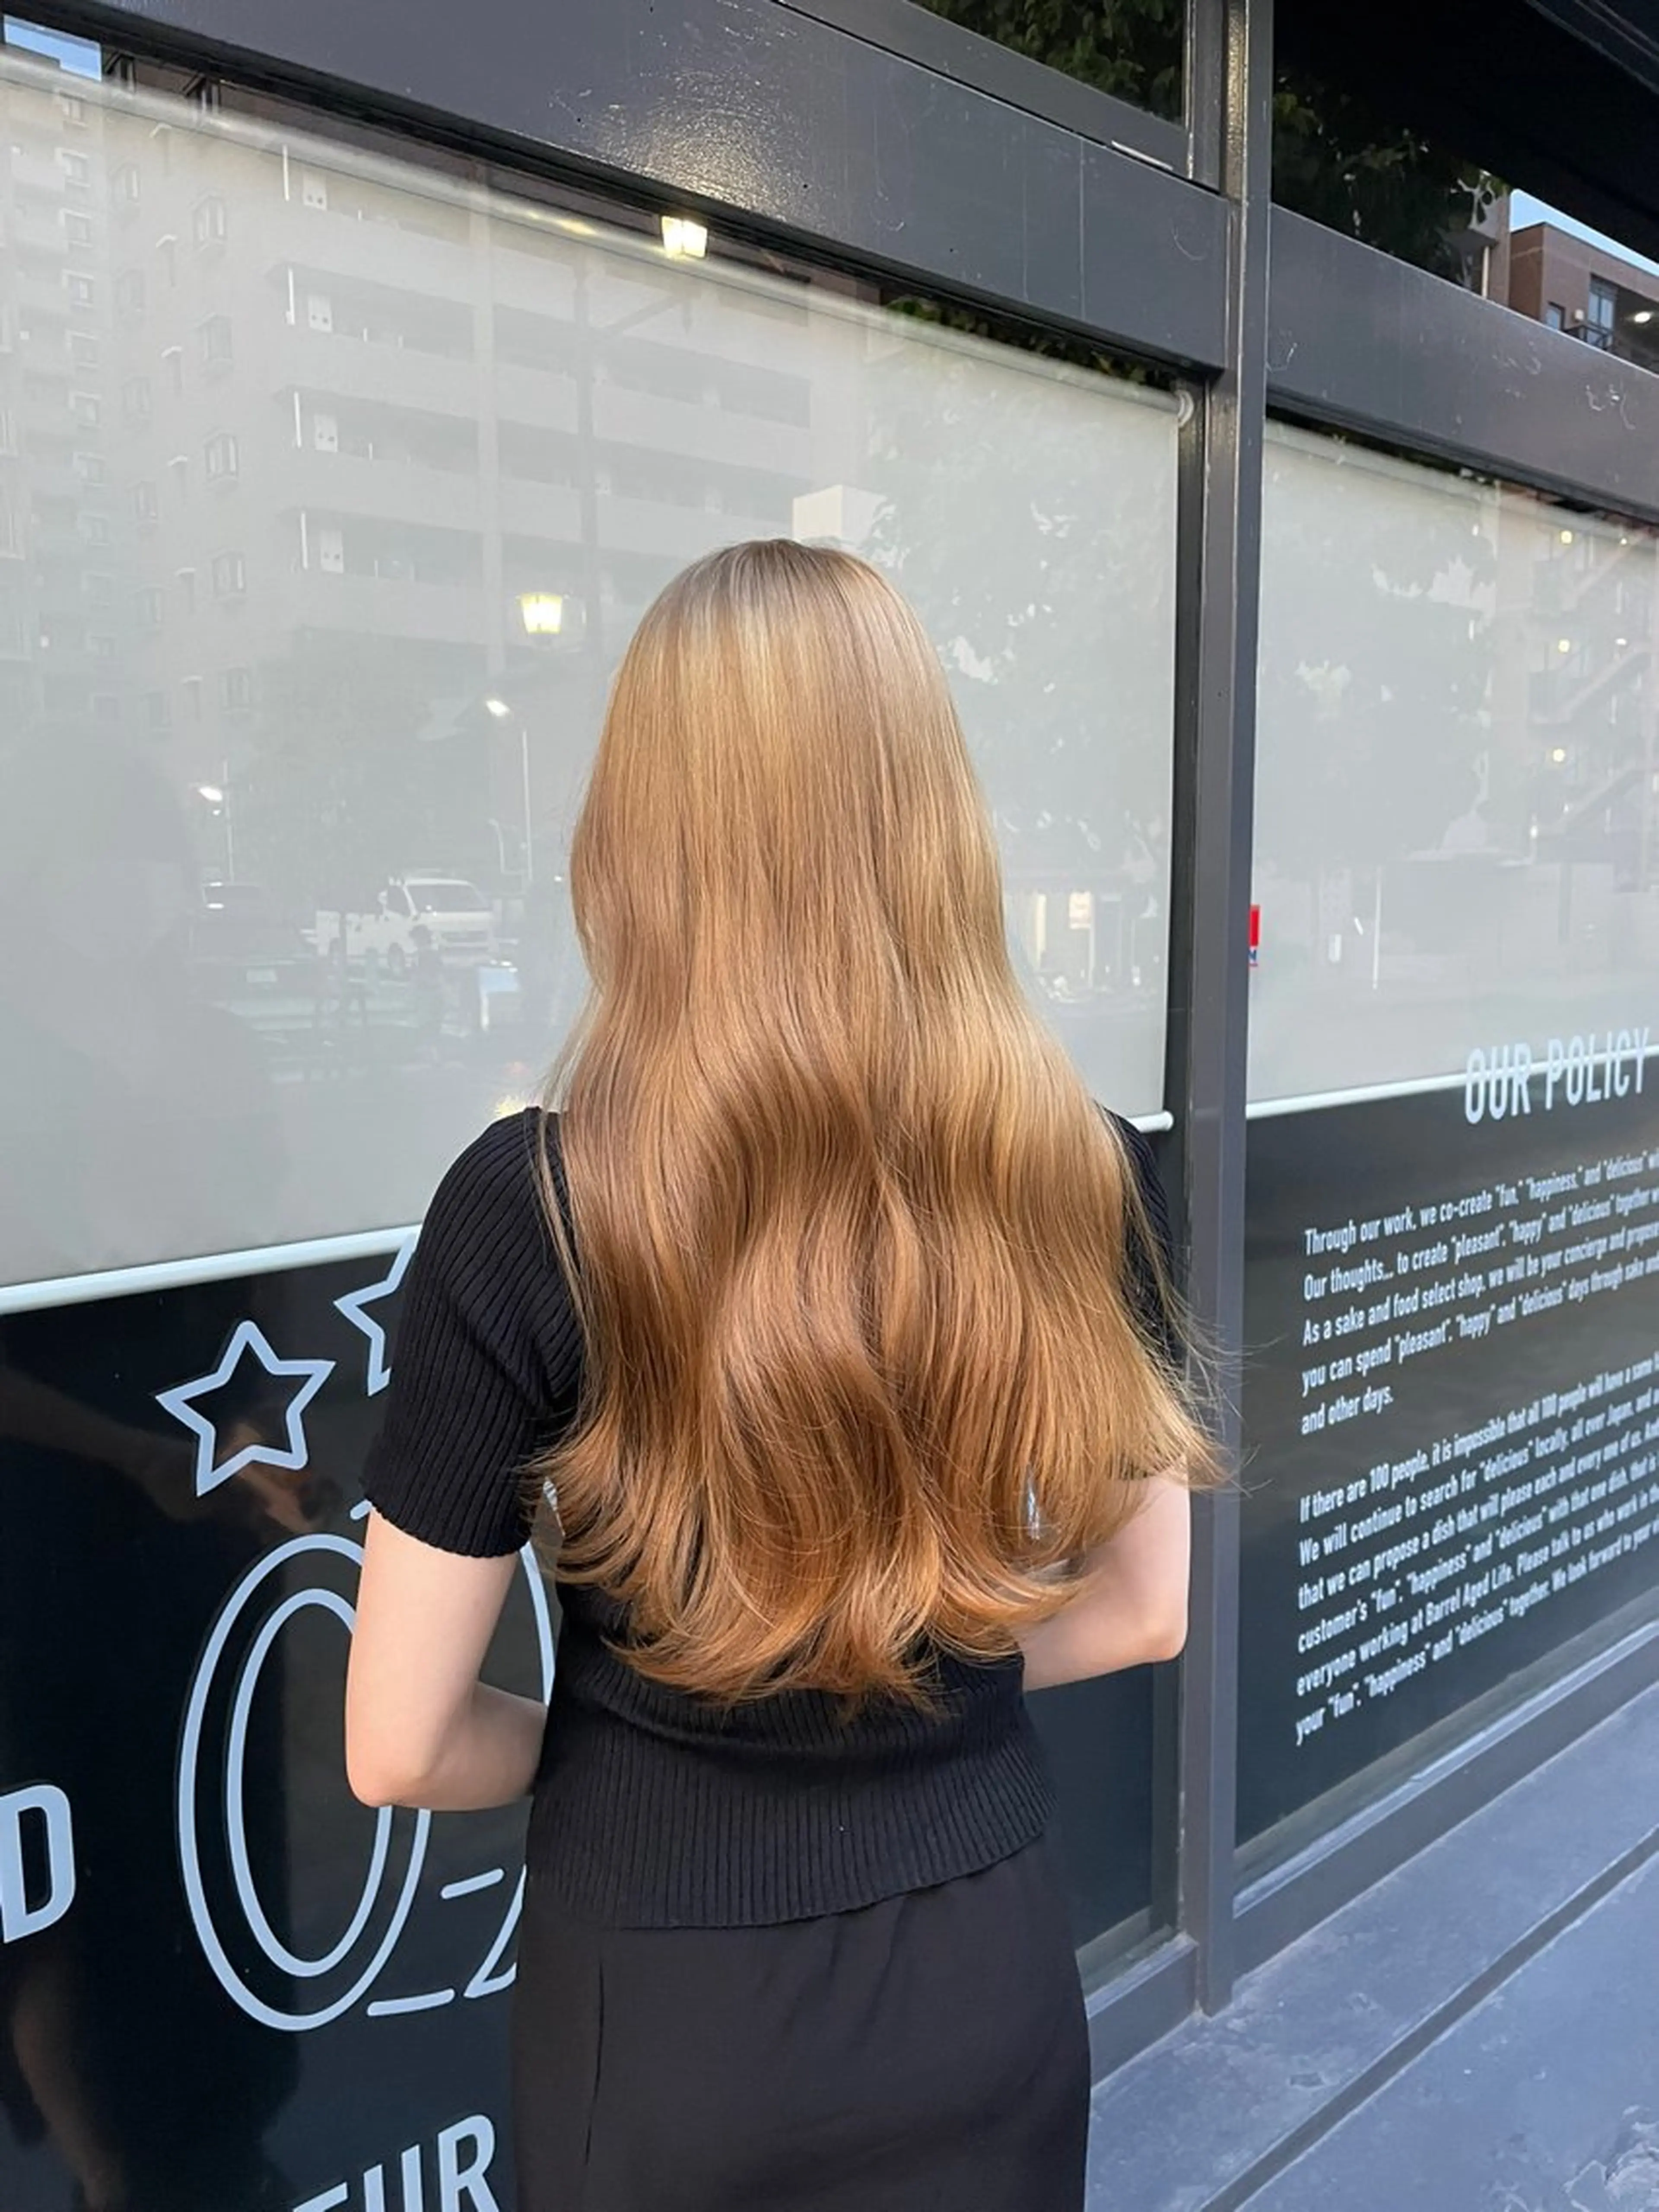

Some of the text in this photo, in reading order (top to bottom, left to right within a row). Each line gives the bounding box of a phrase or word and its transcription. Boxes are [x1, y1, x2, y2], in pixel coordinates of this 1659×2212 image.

[1465, 1027, 1649, 1124] OUR POLICY
[1304, 1274, 1328, 1300] Our
[1397, 1252, 1409, 1274] to
[1412, 1242, 1448, 1271] create
[1305, 1220, 1357, 1255] Through
[1360, 1220, 1381, 1242] our
[1420, 1207, 1437, 1227] we
[1440, 1190, 1493, 1222] co-create
[1302, 1366, 1326, 1397] you
[1329, 1357, 1353, 1381] can
[1356, 1337, 1391, 1376] spend
[1497, 1297, 1516, 1324] and
[1303, 1319, 1320, 1346] As
[1323, 1320, 1332, 1339] a
[1335, 1306, 1365, 1336] sake
[1368, 1296, 1391, 1325] and
[1393, 1287, 1419, 1317] food
[1422, 1278, 1456, 1309] select
[1489, 1268, 1503, 1288] we
[1506, 1256, 1525, 1282] will
[1301, 1402, 1325, 1434] and
[1328, 1395, 1360, 1425] other
[1300, 1495, 1311, 1523] If
[1312, 1488, 1344, 1517] there
[1347, 1479, 1367, 1503] are
[1370, 1463, 1389, 1493] 100
[1432, 1443, 1440, 1466] it
[1442, 1438, 1452, 1462] is
[1454, 1417, 1506, 1457] impossible
[1507, 1408, 1526, 1433] that
[1298, 1577, 1324, 1610] that
[1327, 1572, 1346, 1595] we
[1348, 1560, 1371, 1585] can
[1373, 1536, 1420, 1580] propose
[1422, 1532, 1430, 1550] a
[1432, 1514, 1455, 1545] dish
[1457, 1504, 1478, 1532] that
[1480, 1493, 1499, 1521] will
[1500, 1482, 1532, 1517] please
[1299, 1538, 1319, 1566] We
[1323, 1522, 1347, 1555] will
[1351, 1504, 1402, 1543] continue
[1405, 1496, 1417, 1518] to
[1420, 1474, 1458, 1511] search
[1461, 1469, 1477, 1492] for
[1297, 1650, 1356, 1696] everyone
[1359, 1621, 1408, 1662] working
[1411, 1608, 1423, 1634] at
[1426, 1587, 1461, 1626] Barrel
[1462, 1572, 1489, 1608] Aged
[1298, 1599, 1367, 1653] customer's
[1473, 1532, 1493, 1563] and
[1296, 1707, 1325, 1746] your
[1432, 1629, 1453, 1661] and
